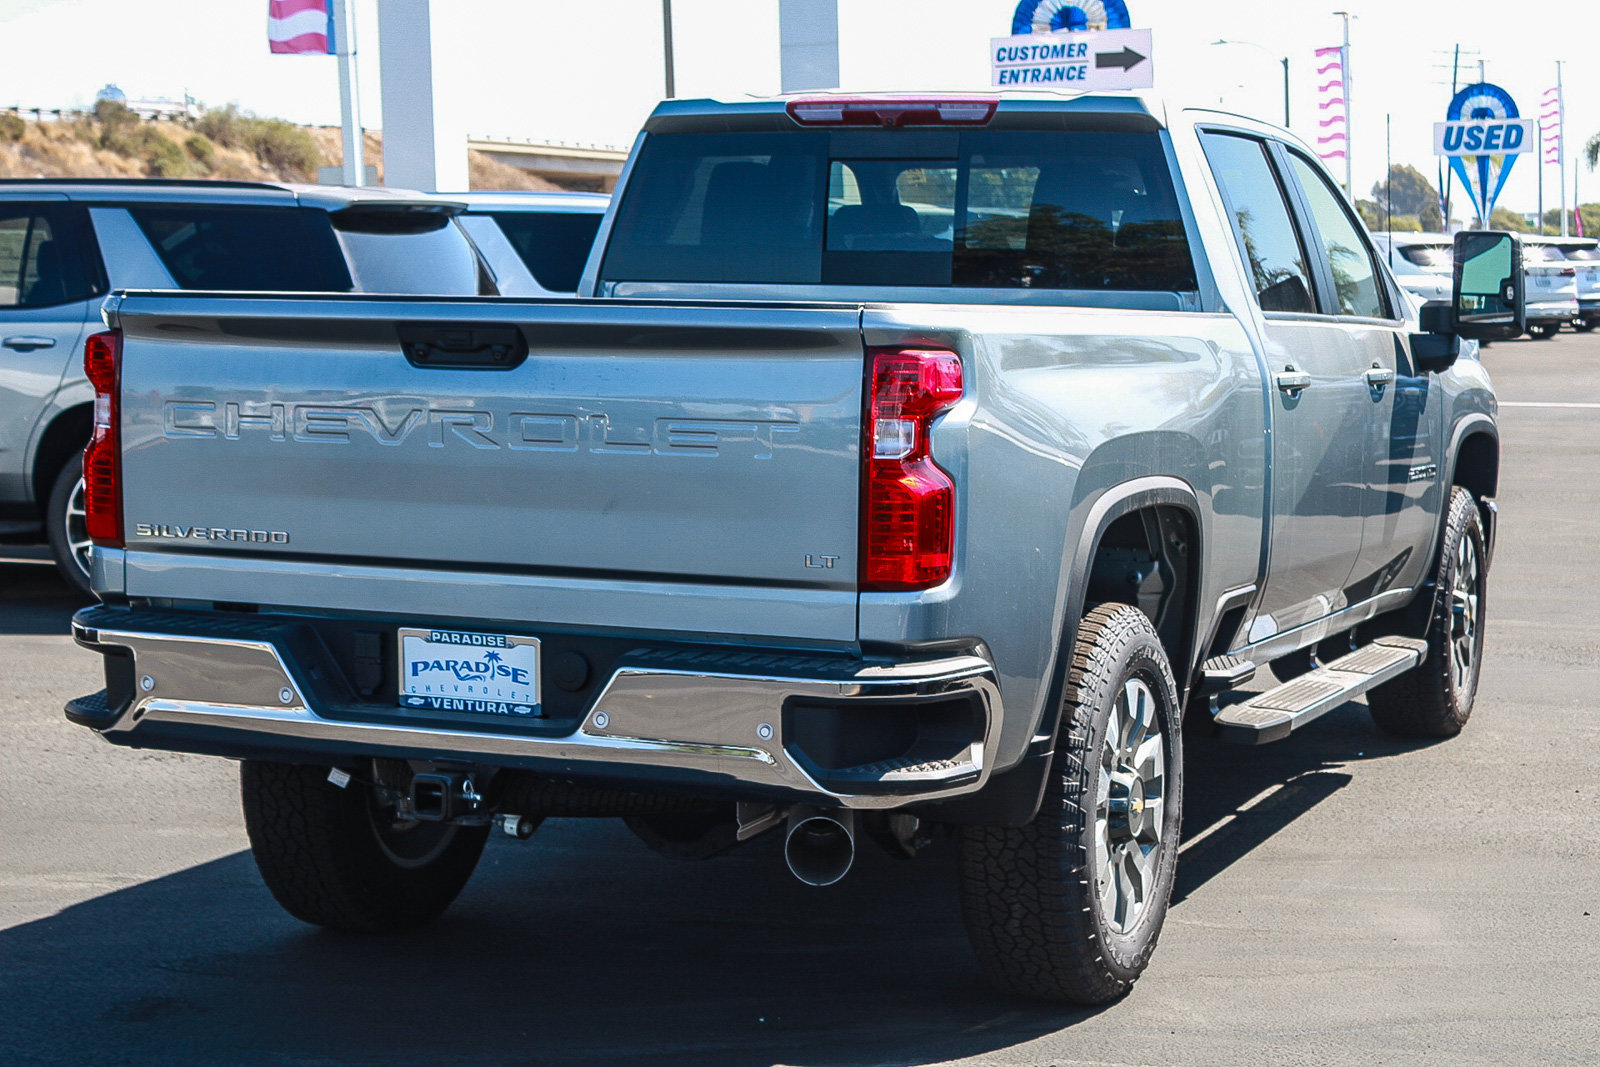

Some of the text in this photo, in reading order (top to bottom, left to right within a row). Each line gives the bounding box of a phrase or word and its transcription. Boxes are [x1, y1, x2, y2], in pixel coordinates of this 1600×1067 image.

[996, 43, 1088, 61] CUSTOMER
[998, 65, 1087, 84] ENTRANCE
[1443, 124, 1524, 151] USED
[163, 400, 800, 459] CHEVROLET
[136, 523, 289, 543] SILVERADO
[805, 554, 840, 568] LT
[432, 632, 505, 647] PARADISE
[411, 651, 530, 686] PARADISE
[411, 685, 529, 702] CHEVROLET
[432, 698, 508, 714] VENTURA
